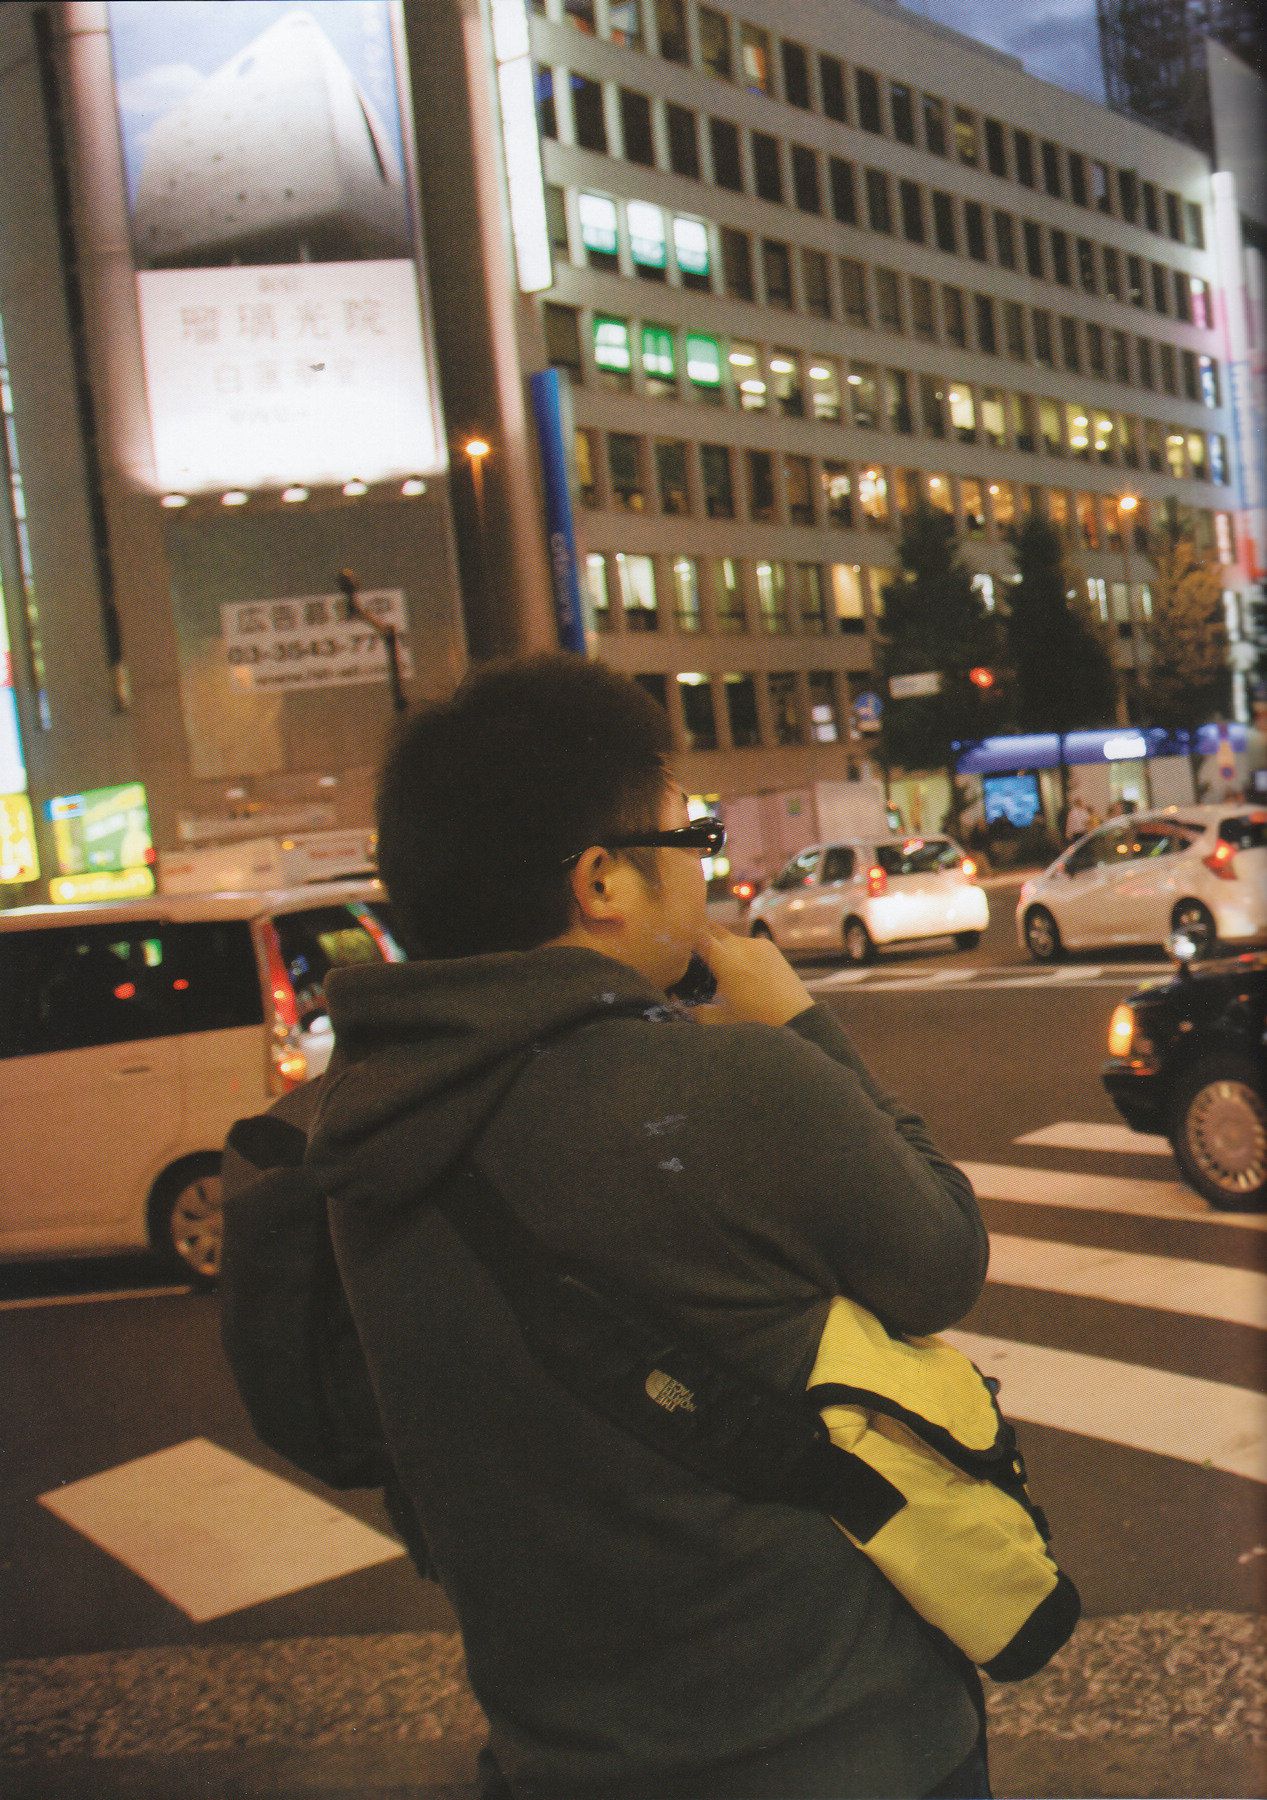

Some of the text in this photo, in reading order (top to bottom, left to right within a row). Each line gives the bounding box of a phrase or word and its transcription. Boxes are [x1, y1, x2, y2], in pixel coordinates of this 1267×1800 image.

[661, 1386, 697, 1413] NORTH
[668, 1379, 694, 1401] FACE
[655, 1393, 677, 1413] THE
